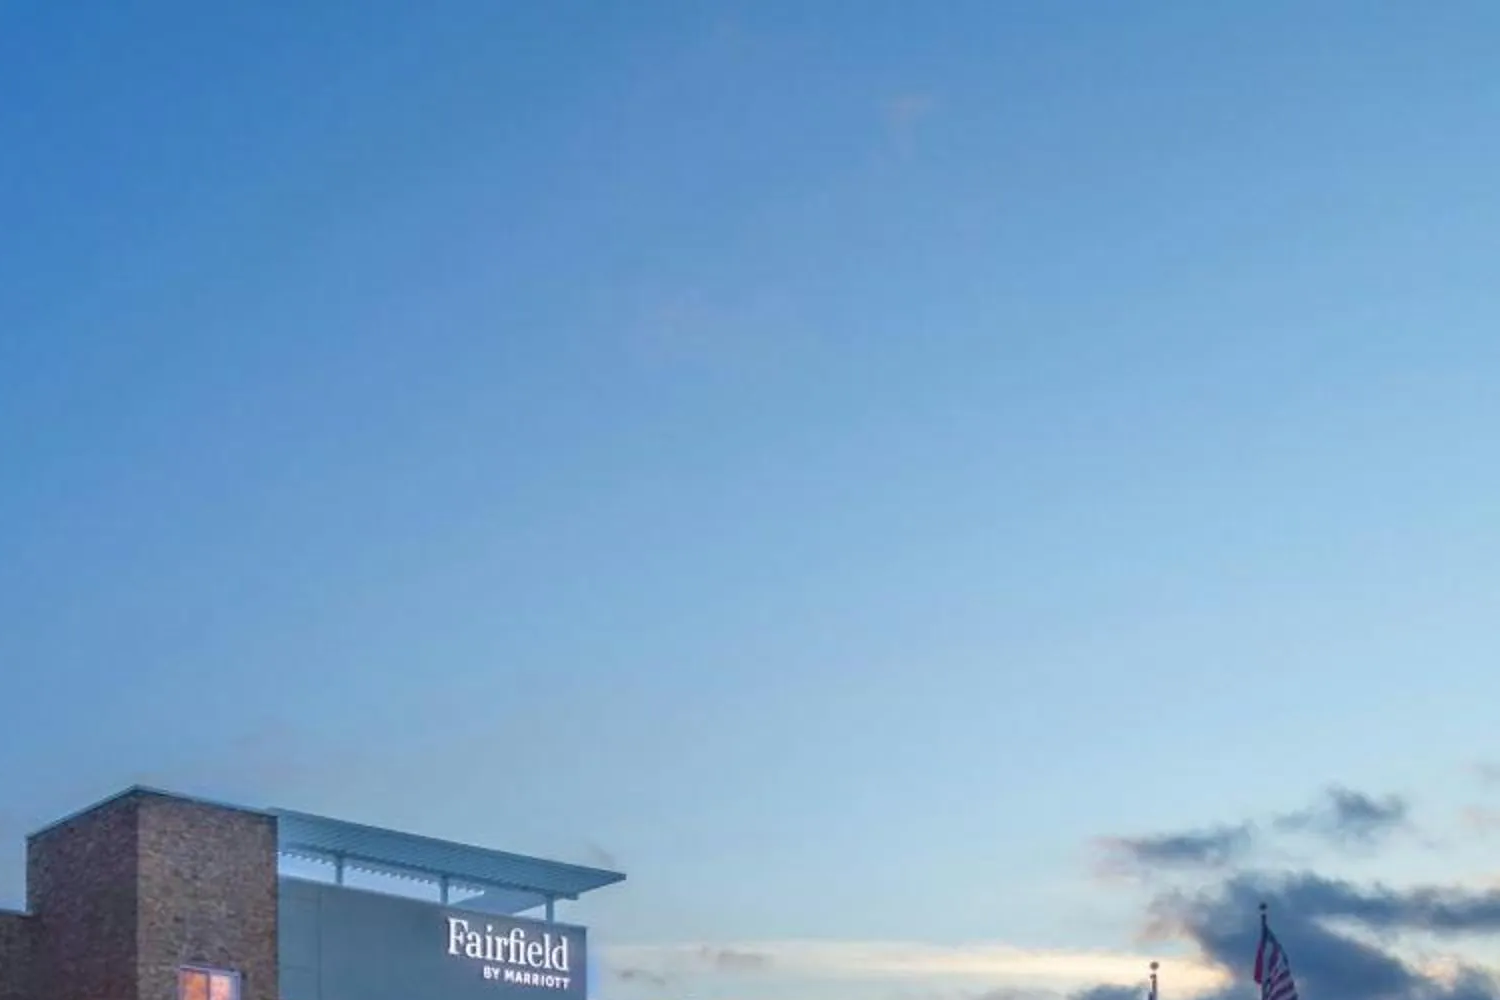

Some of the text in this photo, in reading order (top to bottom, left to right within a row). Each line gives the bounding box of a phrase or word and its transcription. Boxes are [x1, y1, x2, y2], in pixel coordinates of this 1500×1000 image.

[448, 918, 569, 971] Fairfield
[483, 965, 571, 990] BY MARRIOTT
